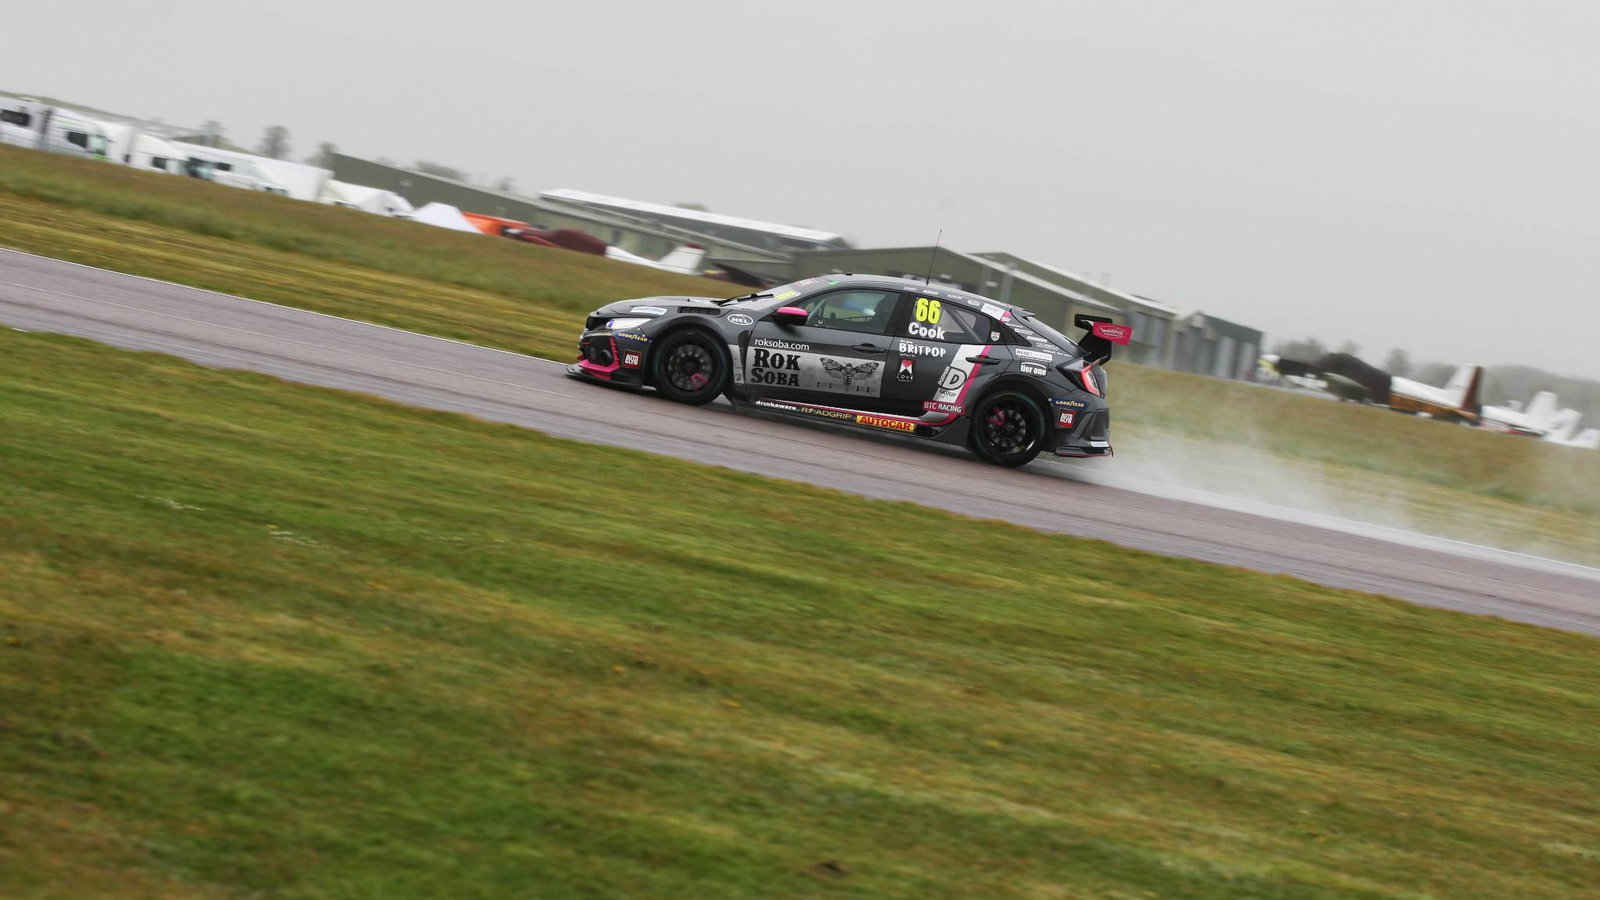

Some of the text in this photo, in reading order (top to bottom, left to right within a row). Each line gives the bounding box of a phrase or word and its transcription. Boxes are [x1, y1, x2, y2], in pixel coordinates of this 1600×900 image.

[915, 298, 941, 324] 66
[908, 321, 945, 340] Cook
[754, 338, 810, 351] roksoba.com
[1020, 364, 1047, 376] tier one
[755, 400, 797, 411] drinkaware
[924, 401, 962, 412] BTC RACING
[859, 416, 912, 431] AUTOCAR
